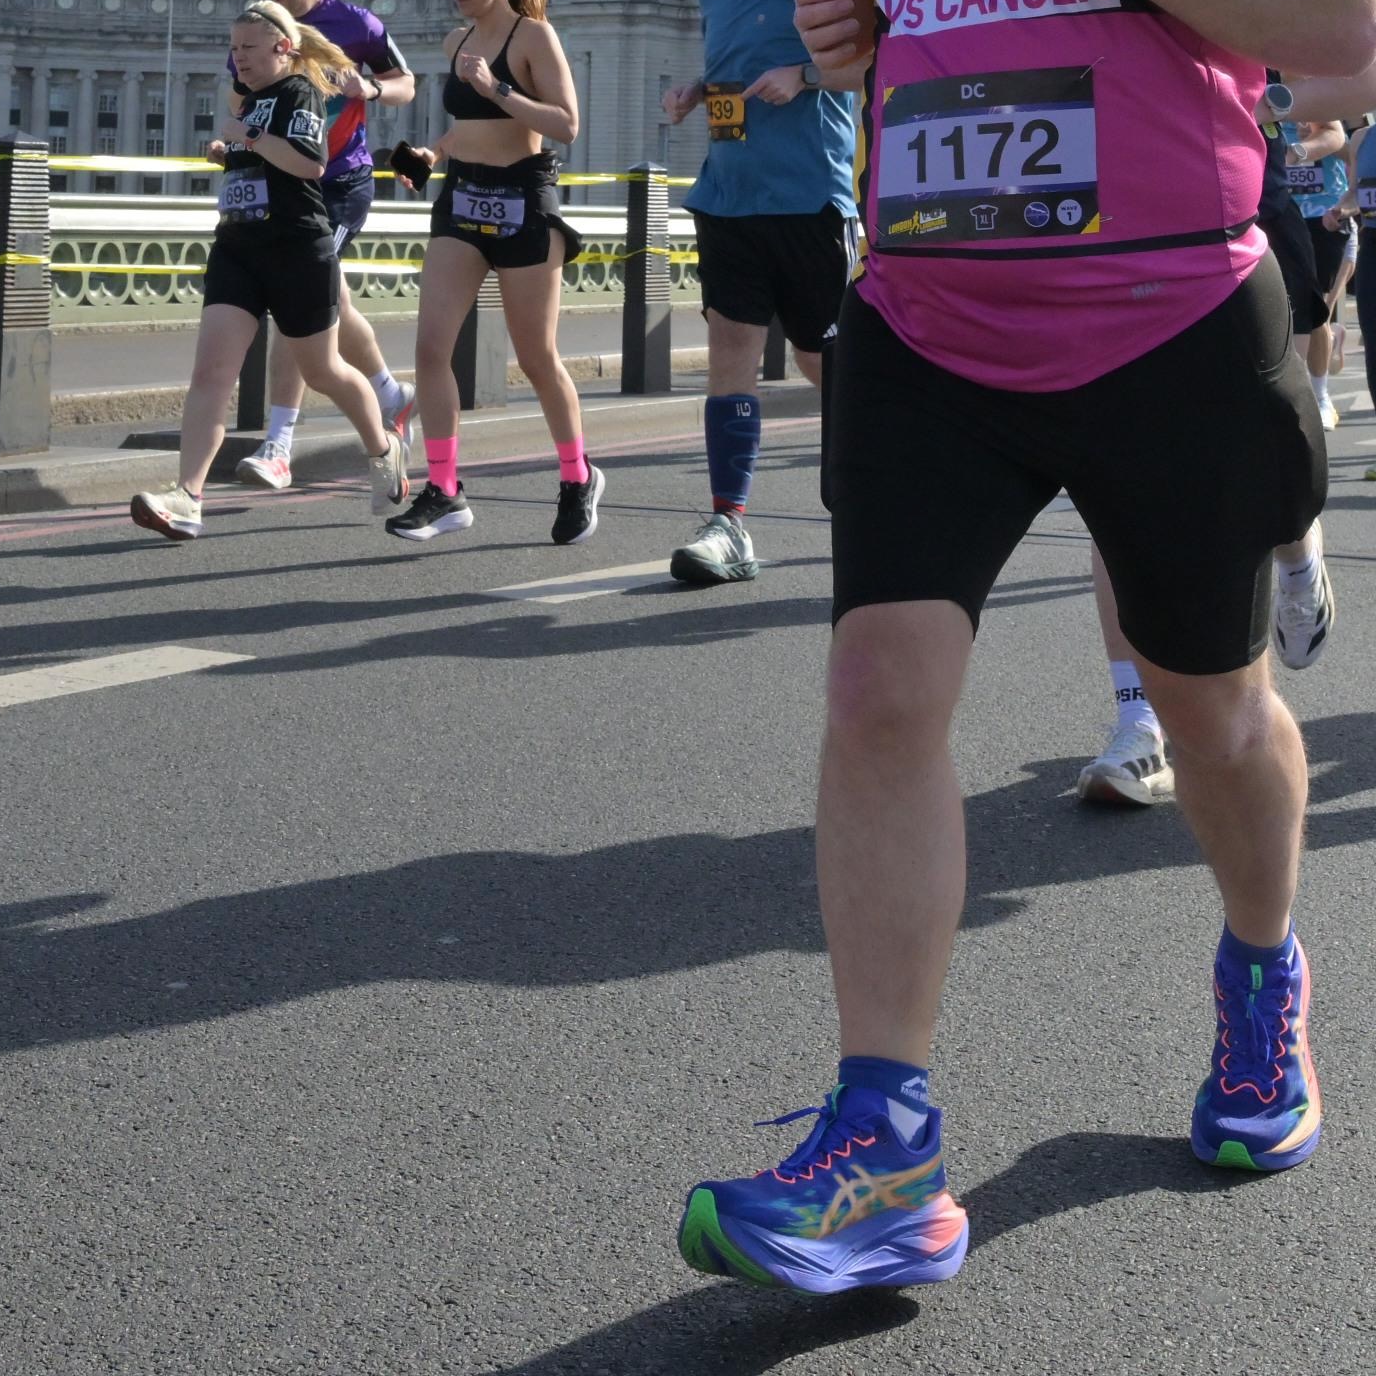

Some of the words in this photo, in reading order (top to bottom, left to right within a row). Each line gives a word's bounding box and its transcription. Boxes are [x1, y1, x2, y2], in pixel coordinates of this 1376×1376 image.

[960, 83, 986, 100] DC
[709, 99, 735, 121] 39
[907, 118, 1062, 184] 1172
[223, 183, 257, 205] 698
[467, 197, 507, 220] 793
[980, 214, 990, 225] XL
[1066, 211, 1073, 222] 1
